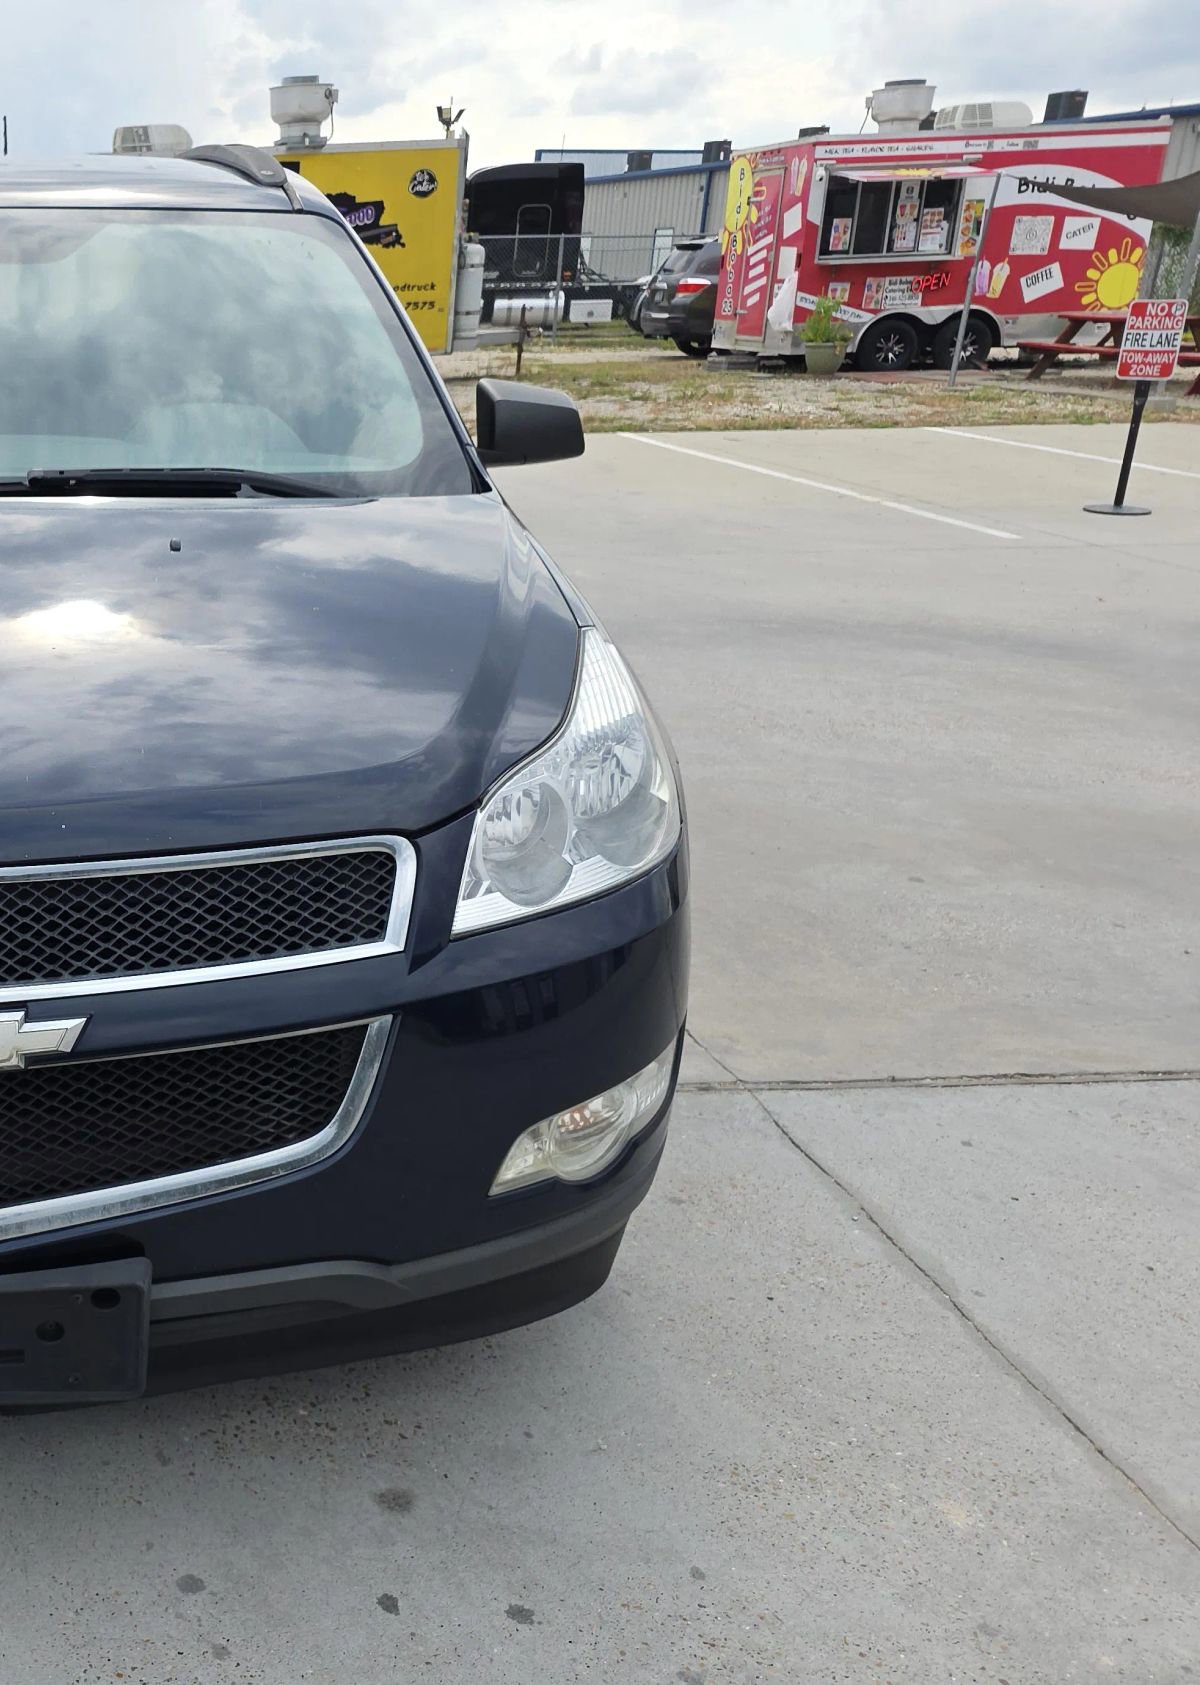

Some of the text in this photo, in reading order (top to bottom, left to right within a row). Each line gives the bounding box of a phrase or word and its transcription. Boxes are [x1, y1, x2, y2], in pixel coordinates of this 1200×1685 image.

[912, 272, 952, 294] OPEN
[1025, 267, 1055, 289] COFFEE
[393, 282, 436, 292] odtruck
[1146, 303, 1169, 316] NO
[1128, 316, 1183, 330] PARKING
[1124, 332, 1180, 348] FIRE LANE
[1122, 352, 1175, 364] TOW-AWAY
[1129, 364, 1161, 376] ZONE
